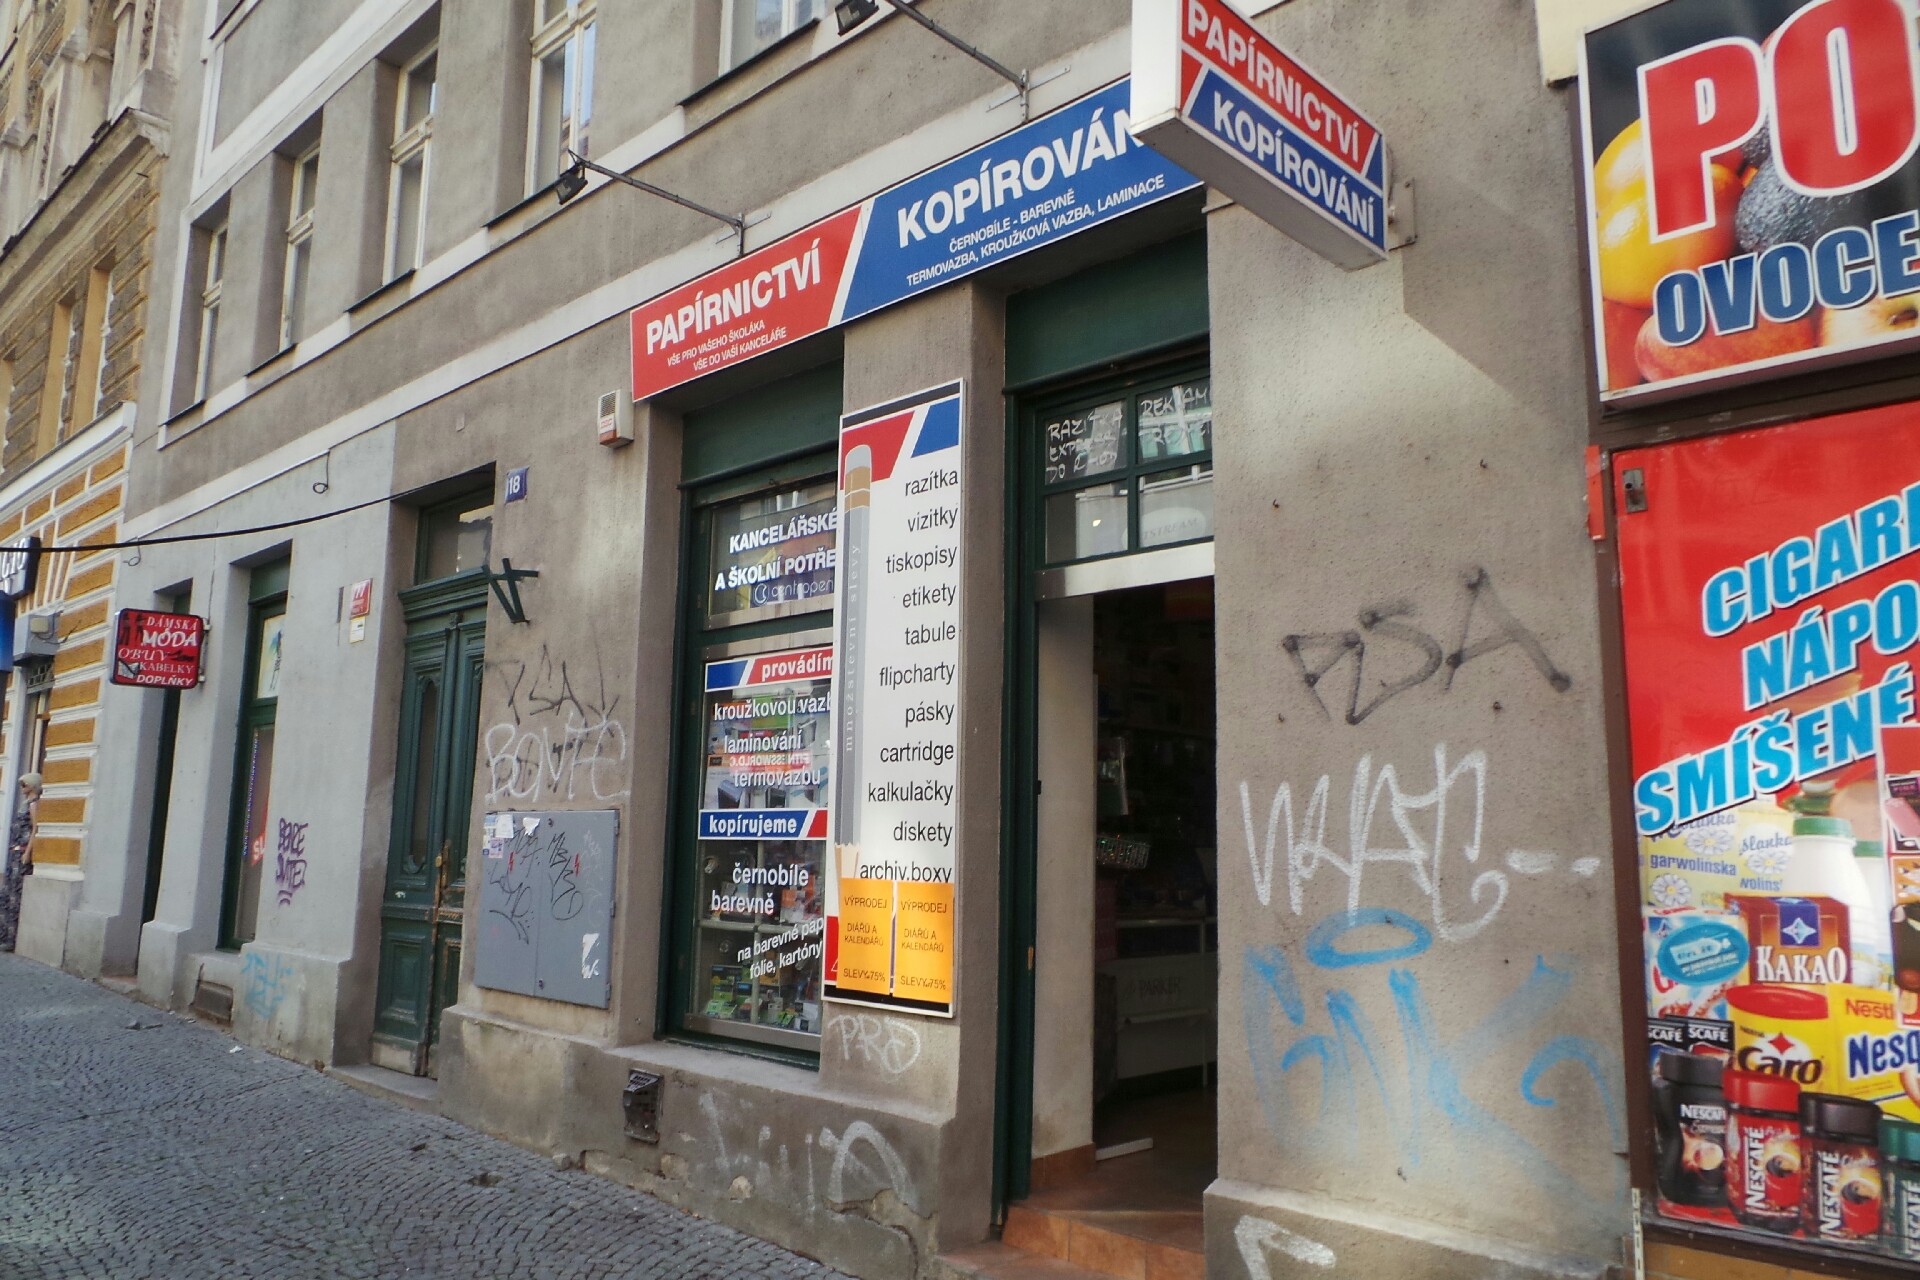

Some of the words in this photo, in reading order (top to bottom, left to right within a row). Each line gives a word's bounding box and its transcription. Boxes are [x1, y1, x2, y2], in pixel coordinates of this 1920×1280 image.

[1187, 0, 1359, 162] PAPÍRNICTVÍ
[1214, 91, 1375, 238] KOPÍROVÁNÍ
[906, 251, 979, 286] TERMOVAZBA,
[980, 220, 1051, 257] KROUŽKOVÁ
[1052, 204, 1095, 231] VAZBA,
[1097, 174, 1165, 212] LAMINACE
[949, 217, 1011, 253] ČERNOBÍLE
[1020, 188, 1075, 224] BAREVNĚ
[1653, 210, 1920, 346] OVOCE
[647, 238, 820, 354] PAPÍRNICTVÍ
[667, 353, 681, 367] VŠE
[682, 347, 697, 361] PRO
[698, 335, 728, 355] VAŠEHO
[729, 320, 765, 343] ŠKOLÁKA
[693, 358, 708, 371] VŠE
[709, 354, 720, 366] DO
[721, 344, 739, 362] VAŠÍ
[739, 327, 787, 354] KANCELÁŘE
[508, 475, 520, 495] 18
[905, 469, 958, 497] razítka
[729, 507, 837, 554] KANCELÁŘSKÉ
[908, 506, 958, 532] vizitky
[714, 572, 726, 591] A
[727, 555, 781, 589] ŠKOLNÍ
[784, 547, 836, 575] POTŘE
[886, 545, 958, 574] tiskopisy
[850, 545, 861, 602] slevy
[902, 583, 956, 608] etikety
[141, 627, 198, 647] MÓDA
[147, 616, 198, 631] DÁMSKÁ
[905, 620, 956, 645] tabule
[118, 647, 171, 661] OBUV
[1742, 579, 1920, 711] NÁPO
[136, 673, 193, 686] DOPLŇKY
[140, 662, 194, 674] KABELKY
[879, 661, 955, 691] flipcharty
[714, 699, 796, 721] kroužkovou
[905, 700, 955, 728] pásky
[724, 730, 802, 754] laminování
[880, 741, 954, 766] cartridge
[1634, 661, 1916, 836] SMÍŠENÉ
[734, 765, 821, 788] termovazbu
[868, 779, 953, 806] kalkulačky
[709, 814, 797, 837] kopírujeme
[893, 821, 953, 847] diskety
[732, 862, 809, 886] černobíle
[860, 861, 952, 883] archiv.boxy
[711, 890, 774, 915] barevně
[844, 895, 887, 909] VÝPRODEJ
[900, 899, 947, 914] VÝPRODEJ
[737, 946, 752, 962] na
[753, 923, 798, 956] barevné
[801, 918, 824, 940] pap
[872, 926, 877, 934] A
[931, 931, 937, 940] A
[749, 960, 776, 979] fólie,
[779, 941, 822, 967] kartóny
[1756, 946, 1848, 984] KAKAO
[1688, 1024, 1728, 1042] SCAFÉ
[1738, 1046, 1823, 1085] Caro
[1744, 1126, 1766, 1212] NESCAFÉ
[1817, 1151, 1841, 1238] NESCAFÉ
